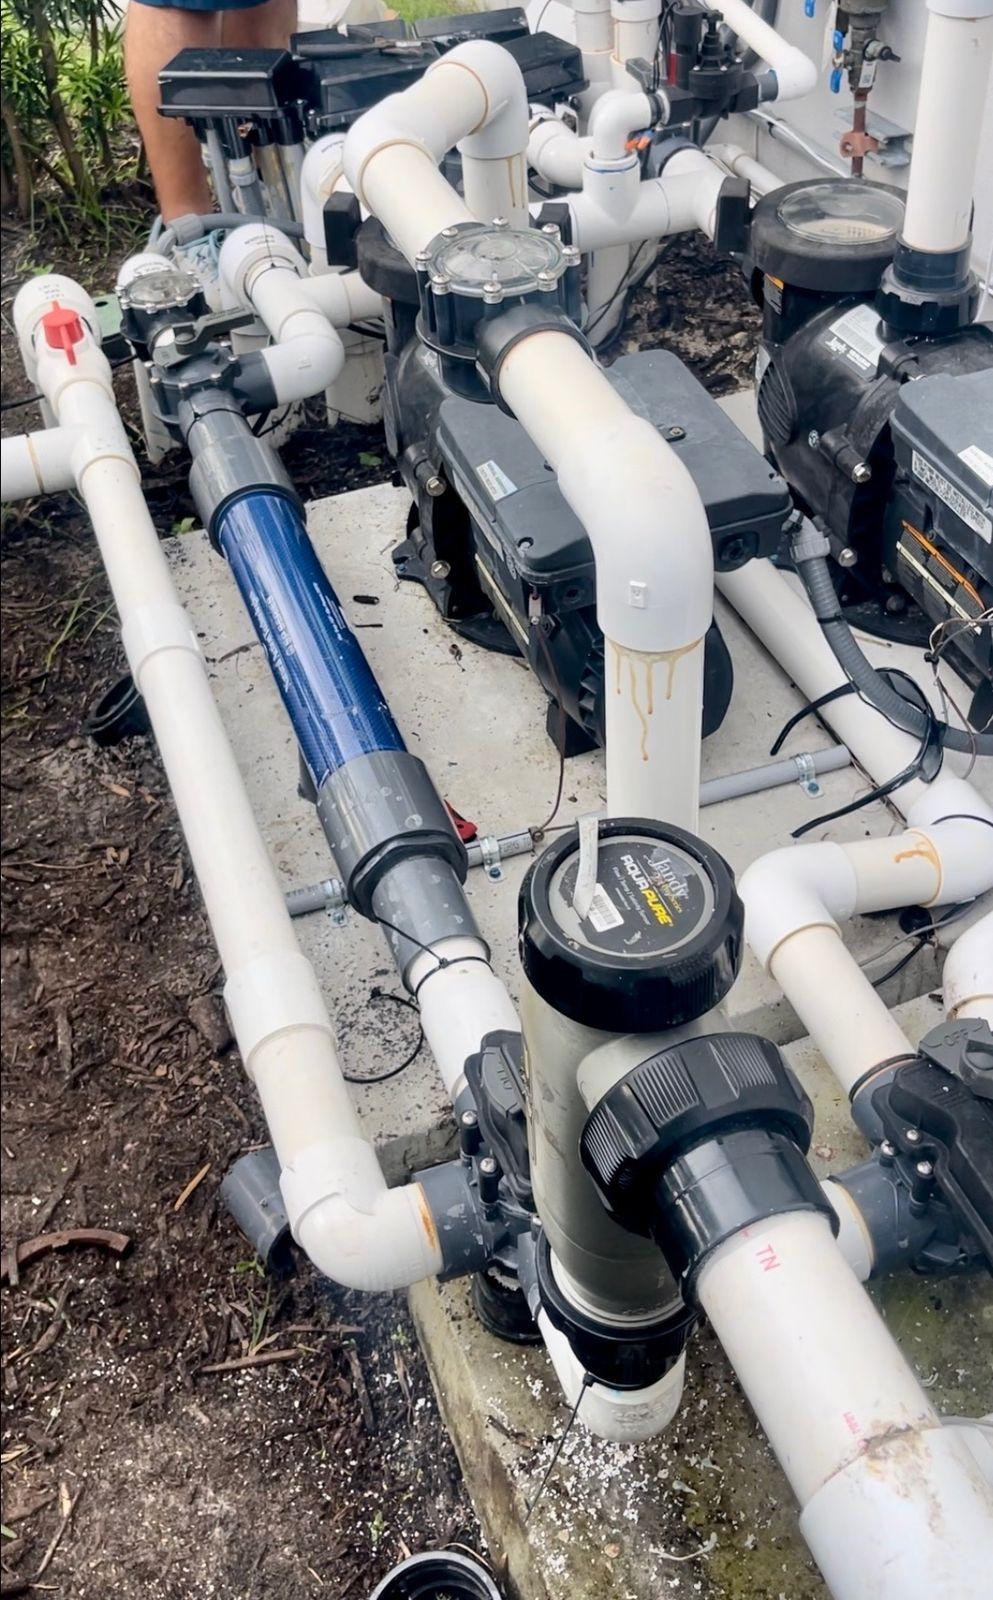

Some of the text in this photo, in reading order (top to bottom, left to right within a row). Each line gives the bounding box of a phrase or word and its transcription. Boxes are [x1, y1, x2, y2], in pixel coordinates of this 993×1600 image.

[643, 855, 688, 896] Jandy
[943, 1028, 969, 1047] OFF
[755, 1244, 781, 1272] TN
